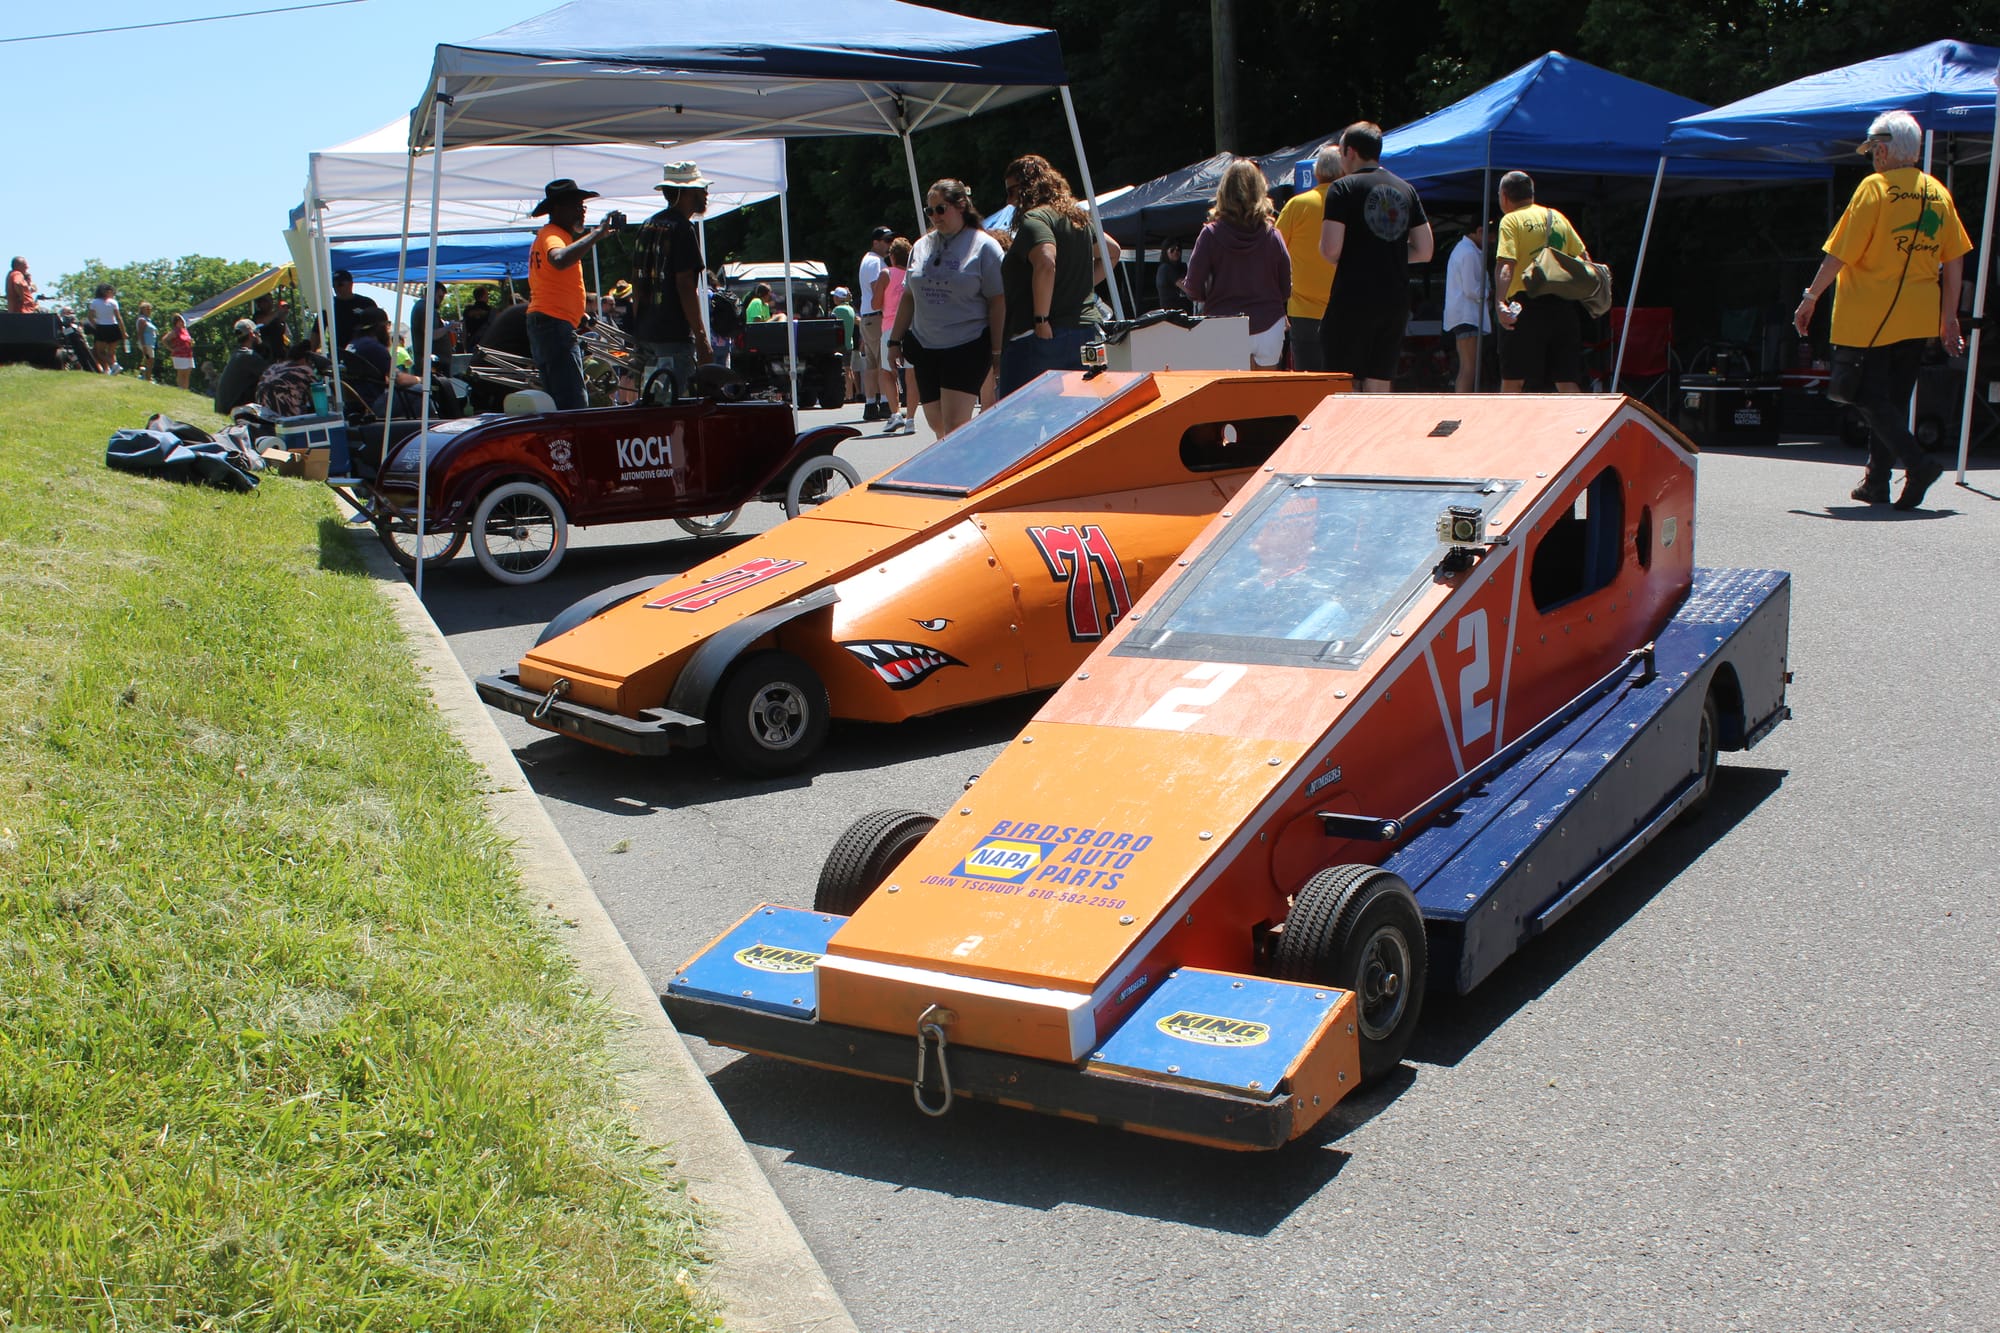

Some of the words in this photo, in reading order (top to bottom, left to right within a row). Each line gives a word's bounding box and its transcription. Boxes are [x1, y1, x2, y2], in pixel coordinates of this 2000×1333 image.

[616, 435, 673, 468] KOCH
[621, 470, 656, 481] AUTOMOTIVE
[656, 468, 674, 478] GROUP
[642, 557, 807, 613] 71
[1025, 525, 1133, 642] 71
[1456, 608, 1493, 747] 2
[1132, 662, 1248, 731] 2
[989, 820, 1153, 852] BIRDSBORO
[970, 848, 1033, 870] NAPA
[1062, 847, 1135, 870] AUTO
[1036, 864, 1125, 891] PARTS
[919, 875, 957, 887] JOHN
[961, 879, 1024, 896] TSCHUDY
[1028, 888, 1126, 910] 610-582-2550
[744, 947, 822, 965] KING
[952, 935, 984, 956] 2
[1166, 1013, 1265, 1037] KING
